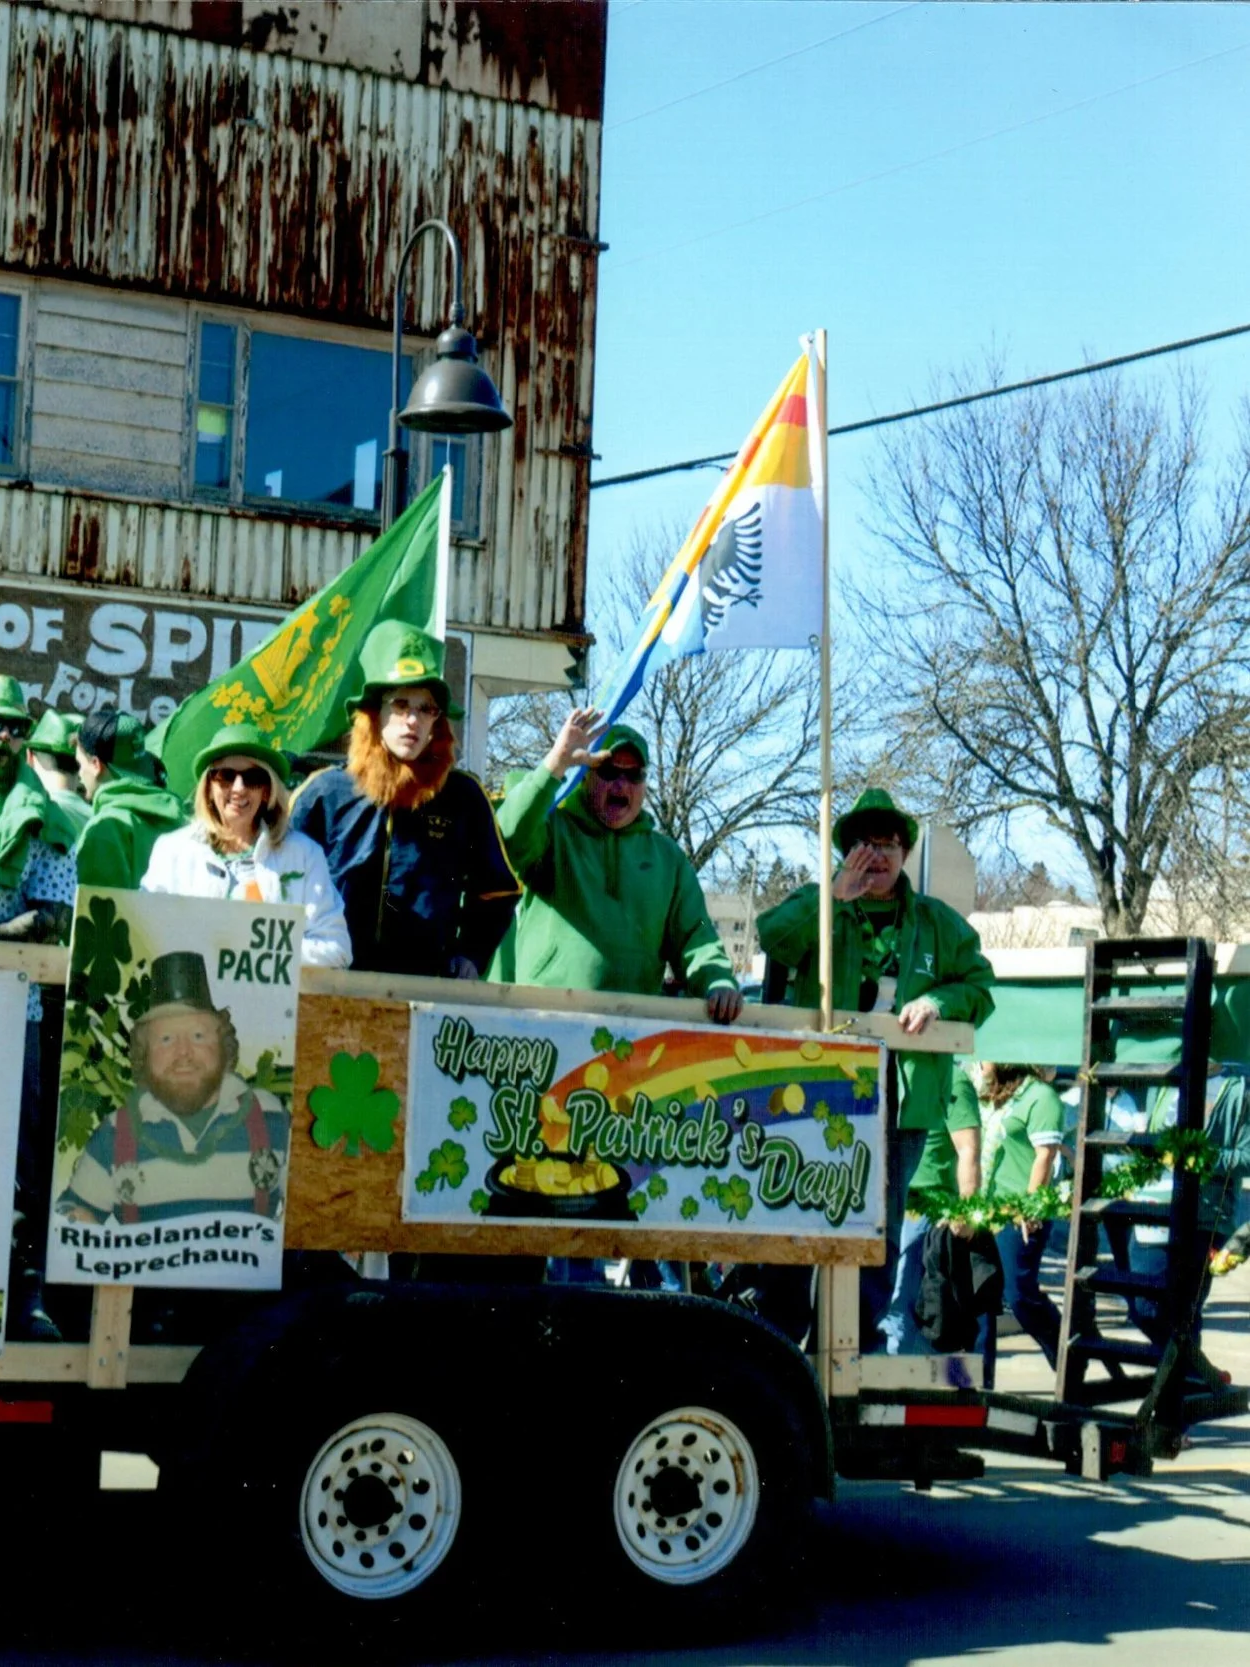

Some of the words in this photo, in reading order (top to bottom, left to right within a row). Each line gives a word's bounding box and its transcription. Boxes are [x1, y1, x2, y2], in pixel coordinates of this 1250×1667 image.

[249, 916, 296, 952] SIX
[216, 948, 293, 986] PACK
[434, 1016, 558, 1094] Happy
[483, 1085, 546, 1157] St.
[565, 1087, 764, 1168] Patrick's
[757, 1136, 869, 1228] Day!
[60, 1220, 275, 1249] Rhinelander's
[75, 1247, 260, 1280] Leprechaun
